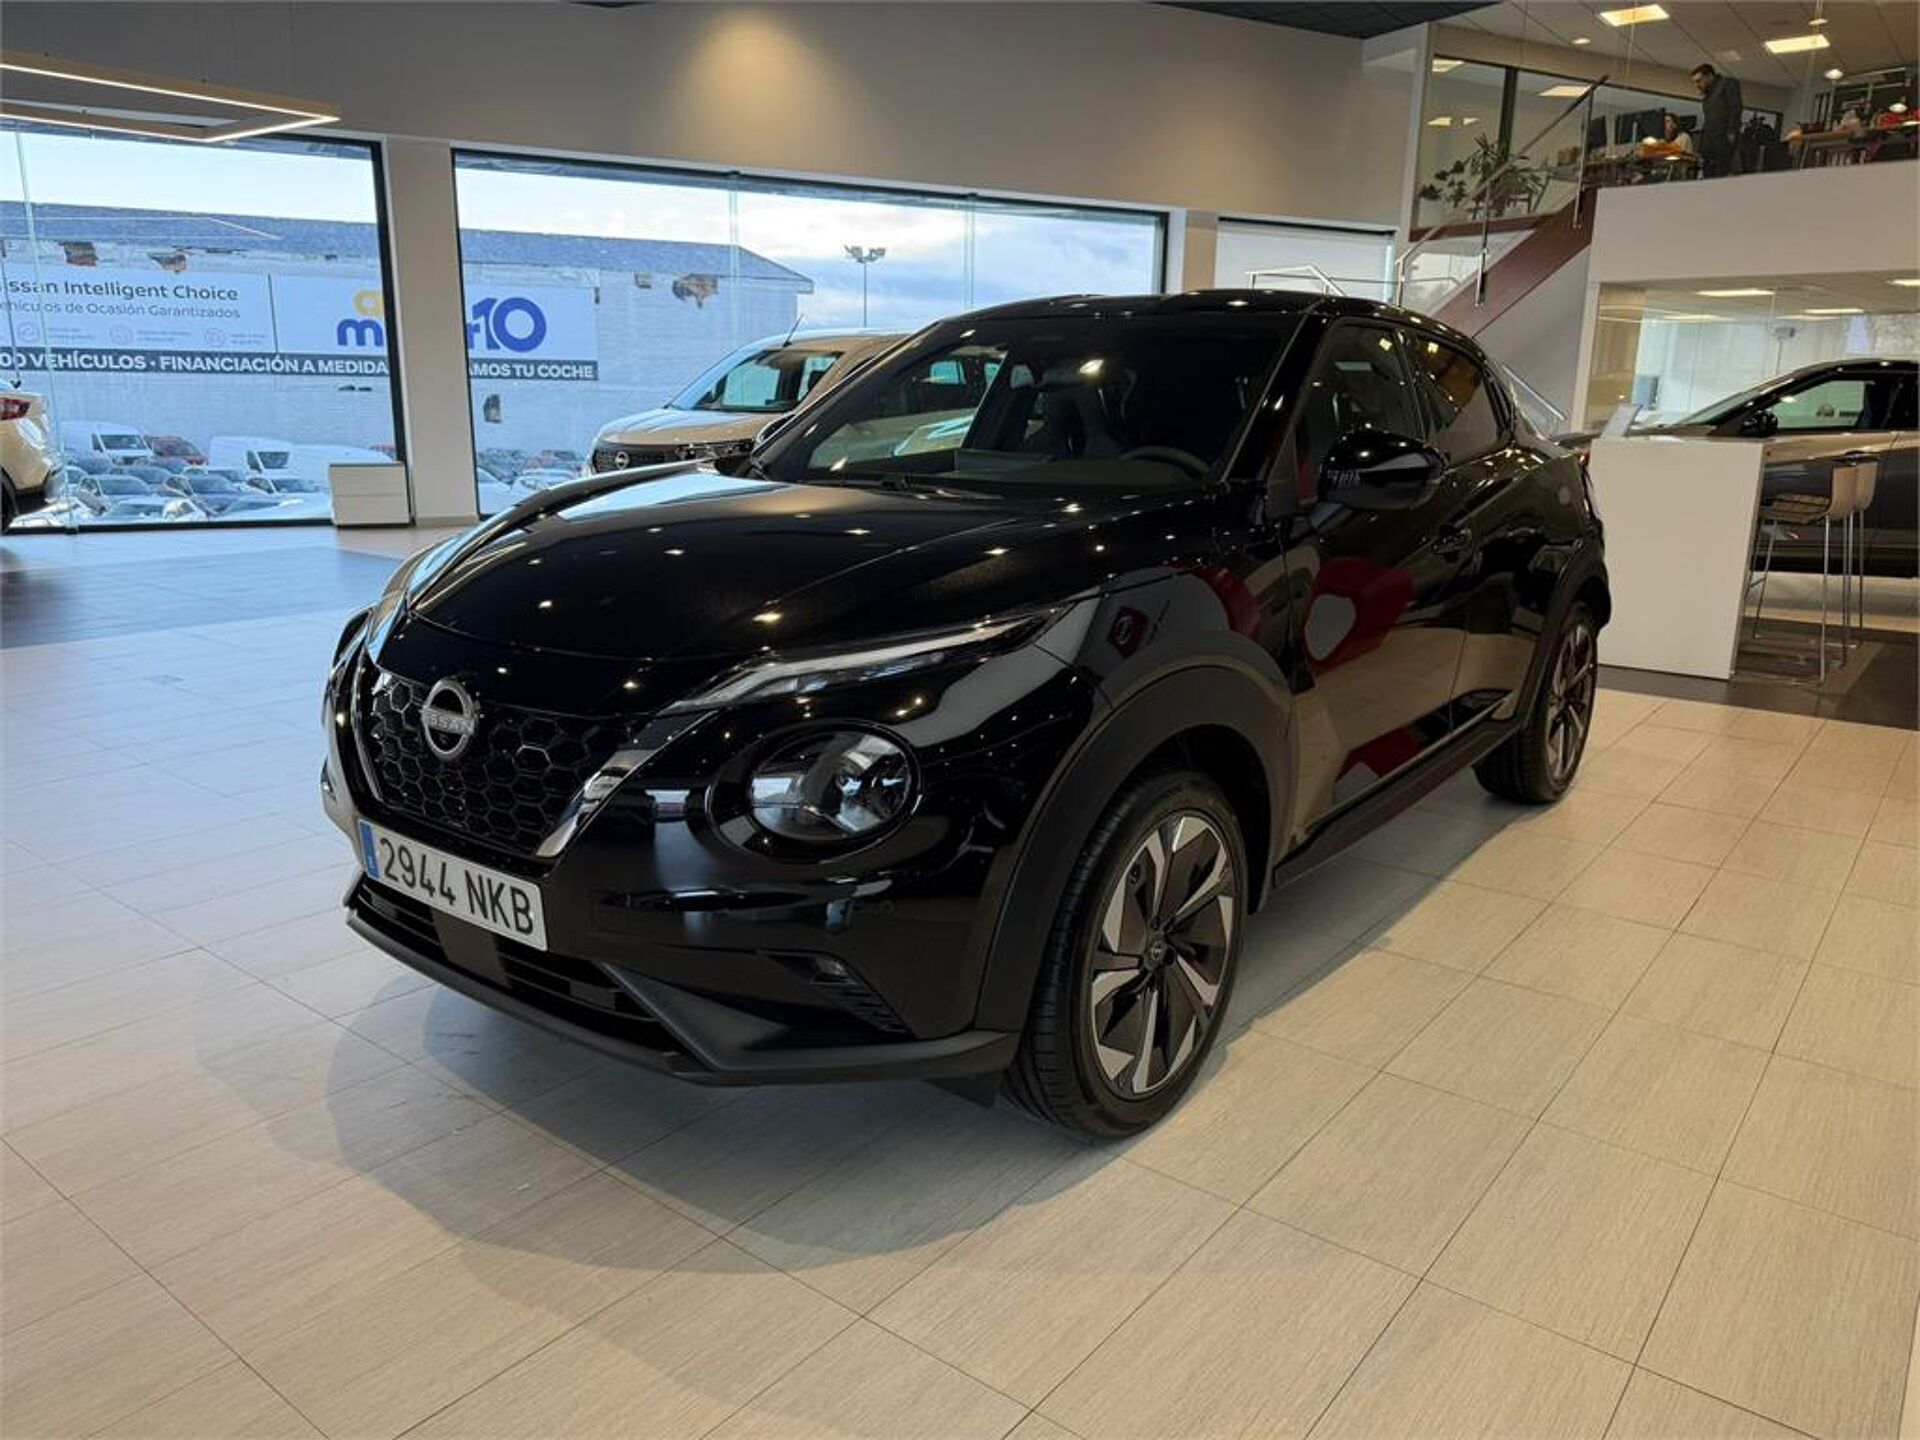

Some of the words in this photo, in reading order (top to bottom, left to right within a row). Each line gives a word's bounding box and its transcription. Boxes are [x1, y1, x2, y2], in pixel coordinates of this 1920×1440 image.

[64, 281, 168, 300] Intelligent
[173, 284, 239, 301] Choice
[65, 302, 83, 314] de
[86, 302, 146, 316] Ocasión
[148, 305, 241, 318] Garantizados
[29, 350, 147, 370] VEHÍCULOS
[160, 354, 299, 373] FINANCIACIÓN
[301, 359, 316, 374] A
[318, 360, 389, 375] MEDIDA
[512, 364, 535, 377] TU
[537, 365, 595, 378] COCHE
[379, 837, 456, 905] 2944
[464, 869, 534, 935] NKB
